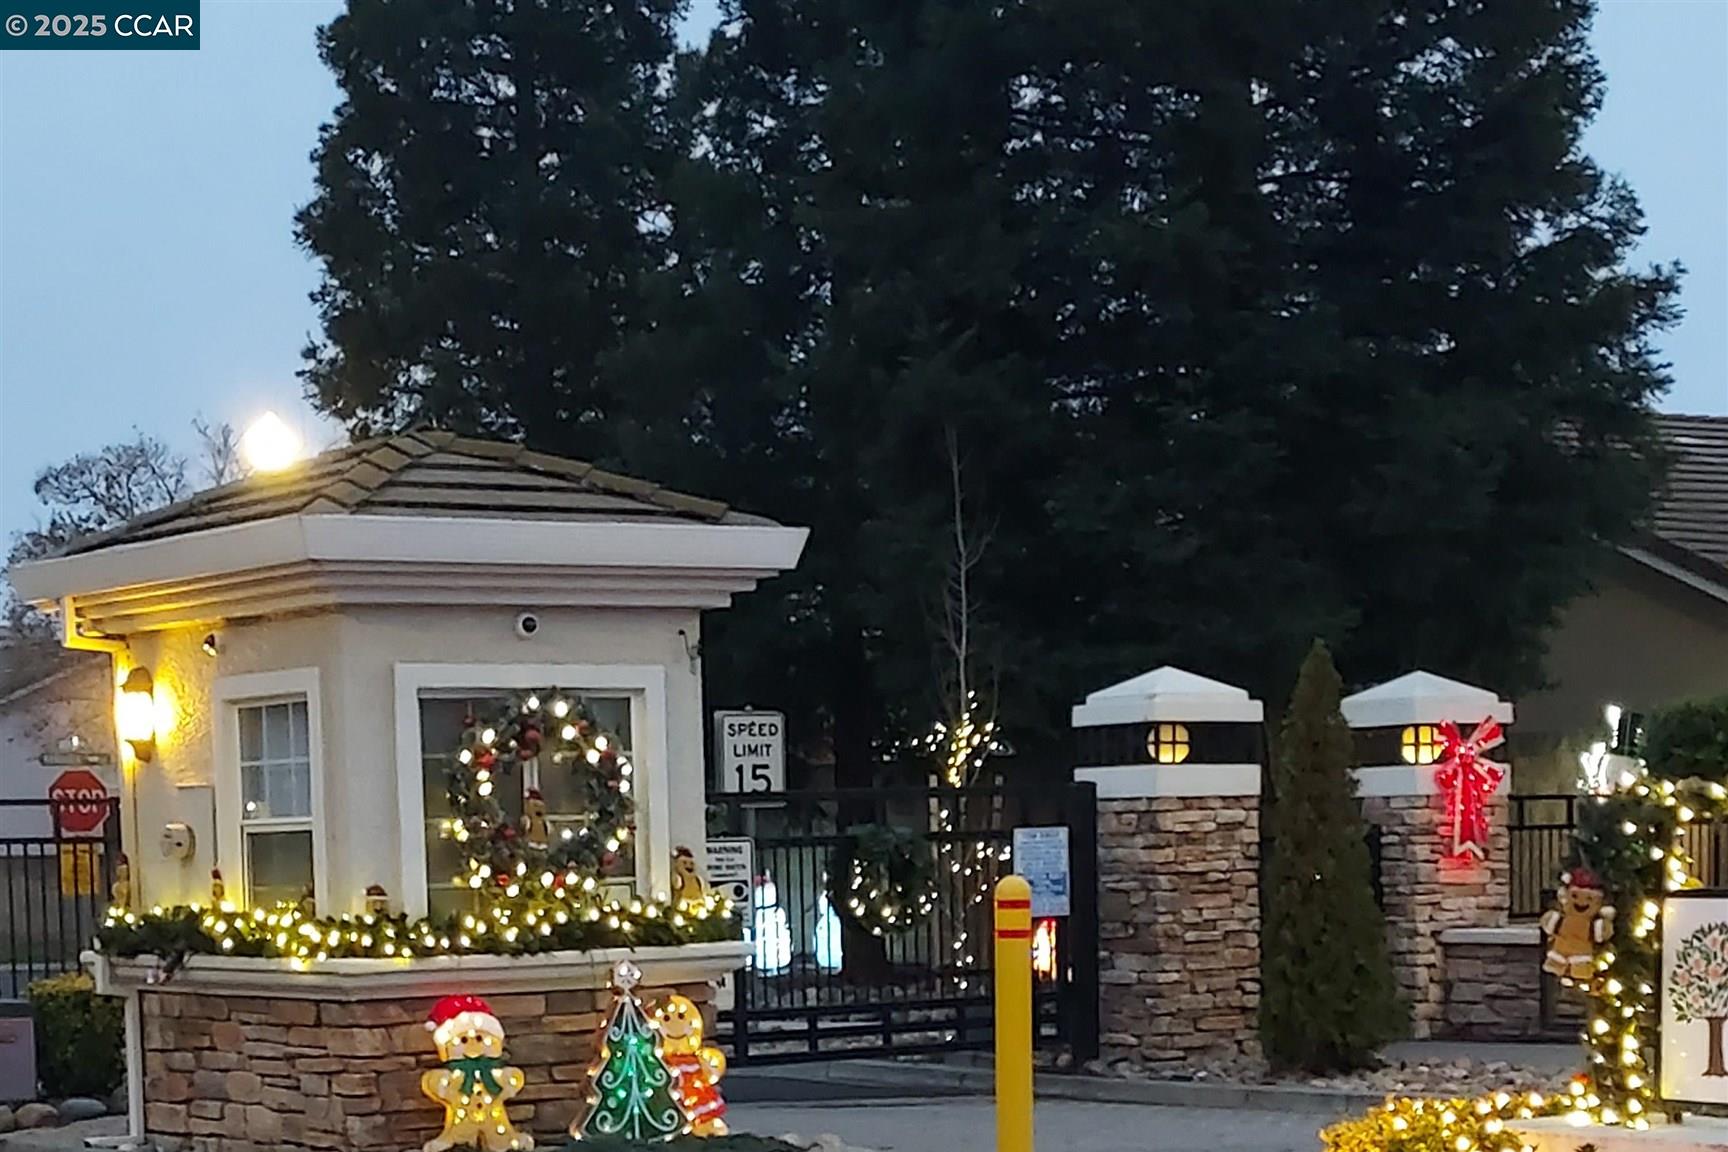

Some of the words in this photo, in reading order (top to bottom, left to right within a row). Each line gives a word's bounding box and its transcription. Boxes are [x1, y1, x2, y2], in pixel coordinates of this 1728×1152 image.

[728, 722, 778, 737] SPEED
[733, 743, 772, 757] LIMIT
[735, 764, 772, 793] 15
[52, 788, 104, 813] STOP
